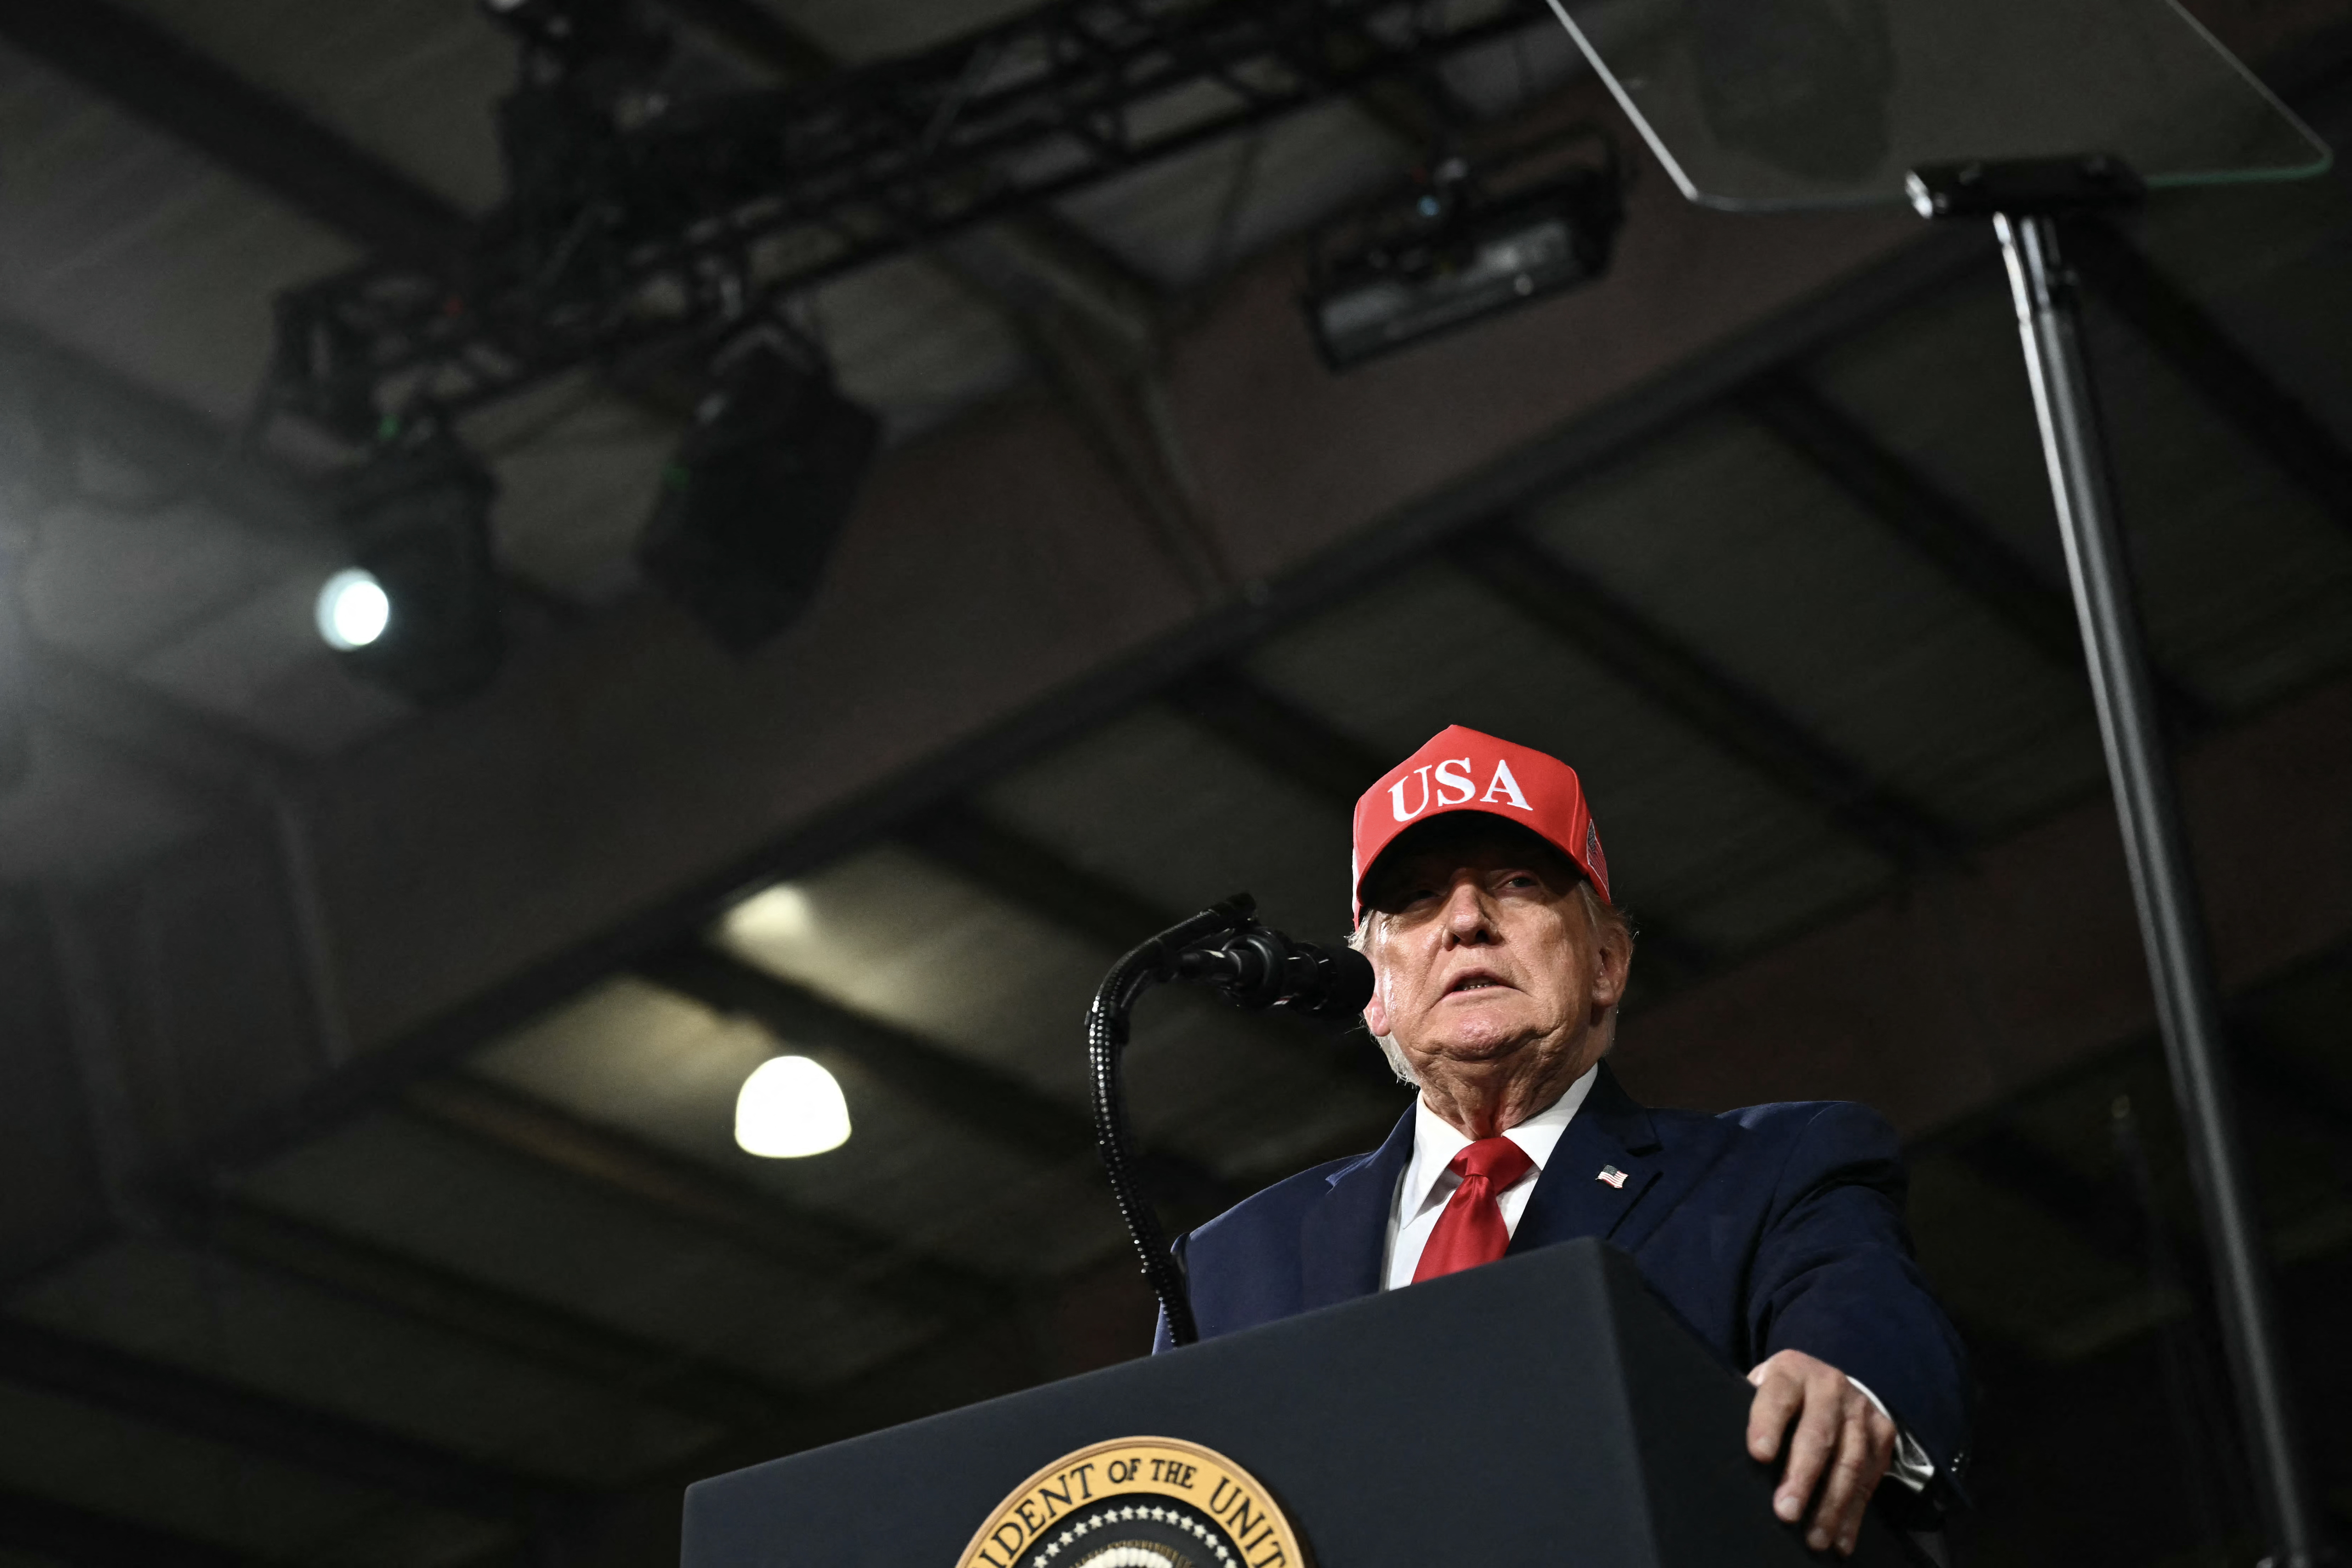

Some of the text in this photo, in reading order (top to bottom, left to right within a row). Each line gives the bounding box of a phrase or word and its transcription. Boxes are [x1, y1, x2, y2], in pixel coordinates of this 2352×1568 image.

[1387, 757, 1533, 822] USA
[973, 1459, 1286, 1568] IDENT OF THE UNIT
